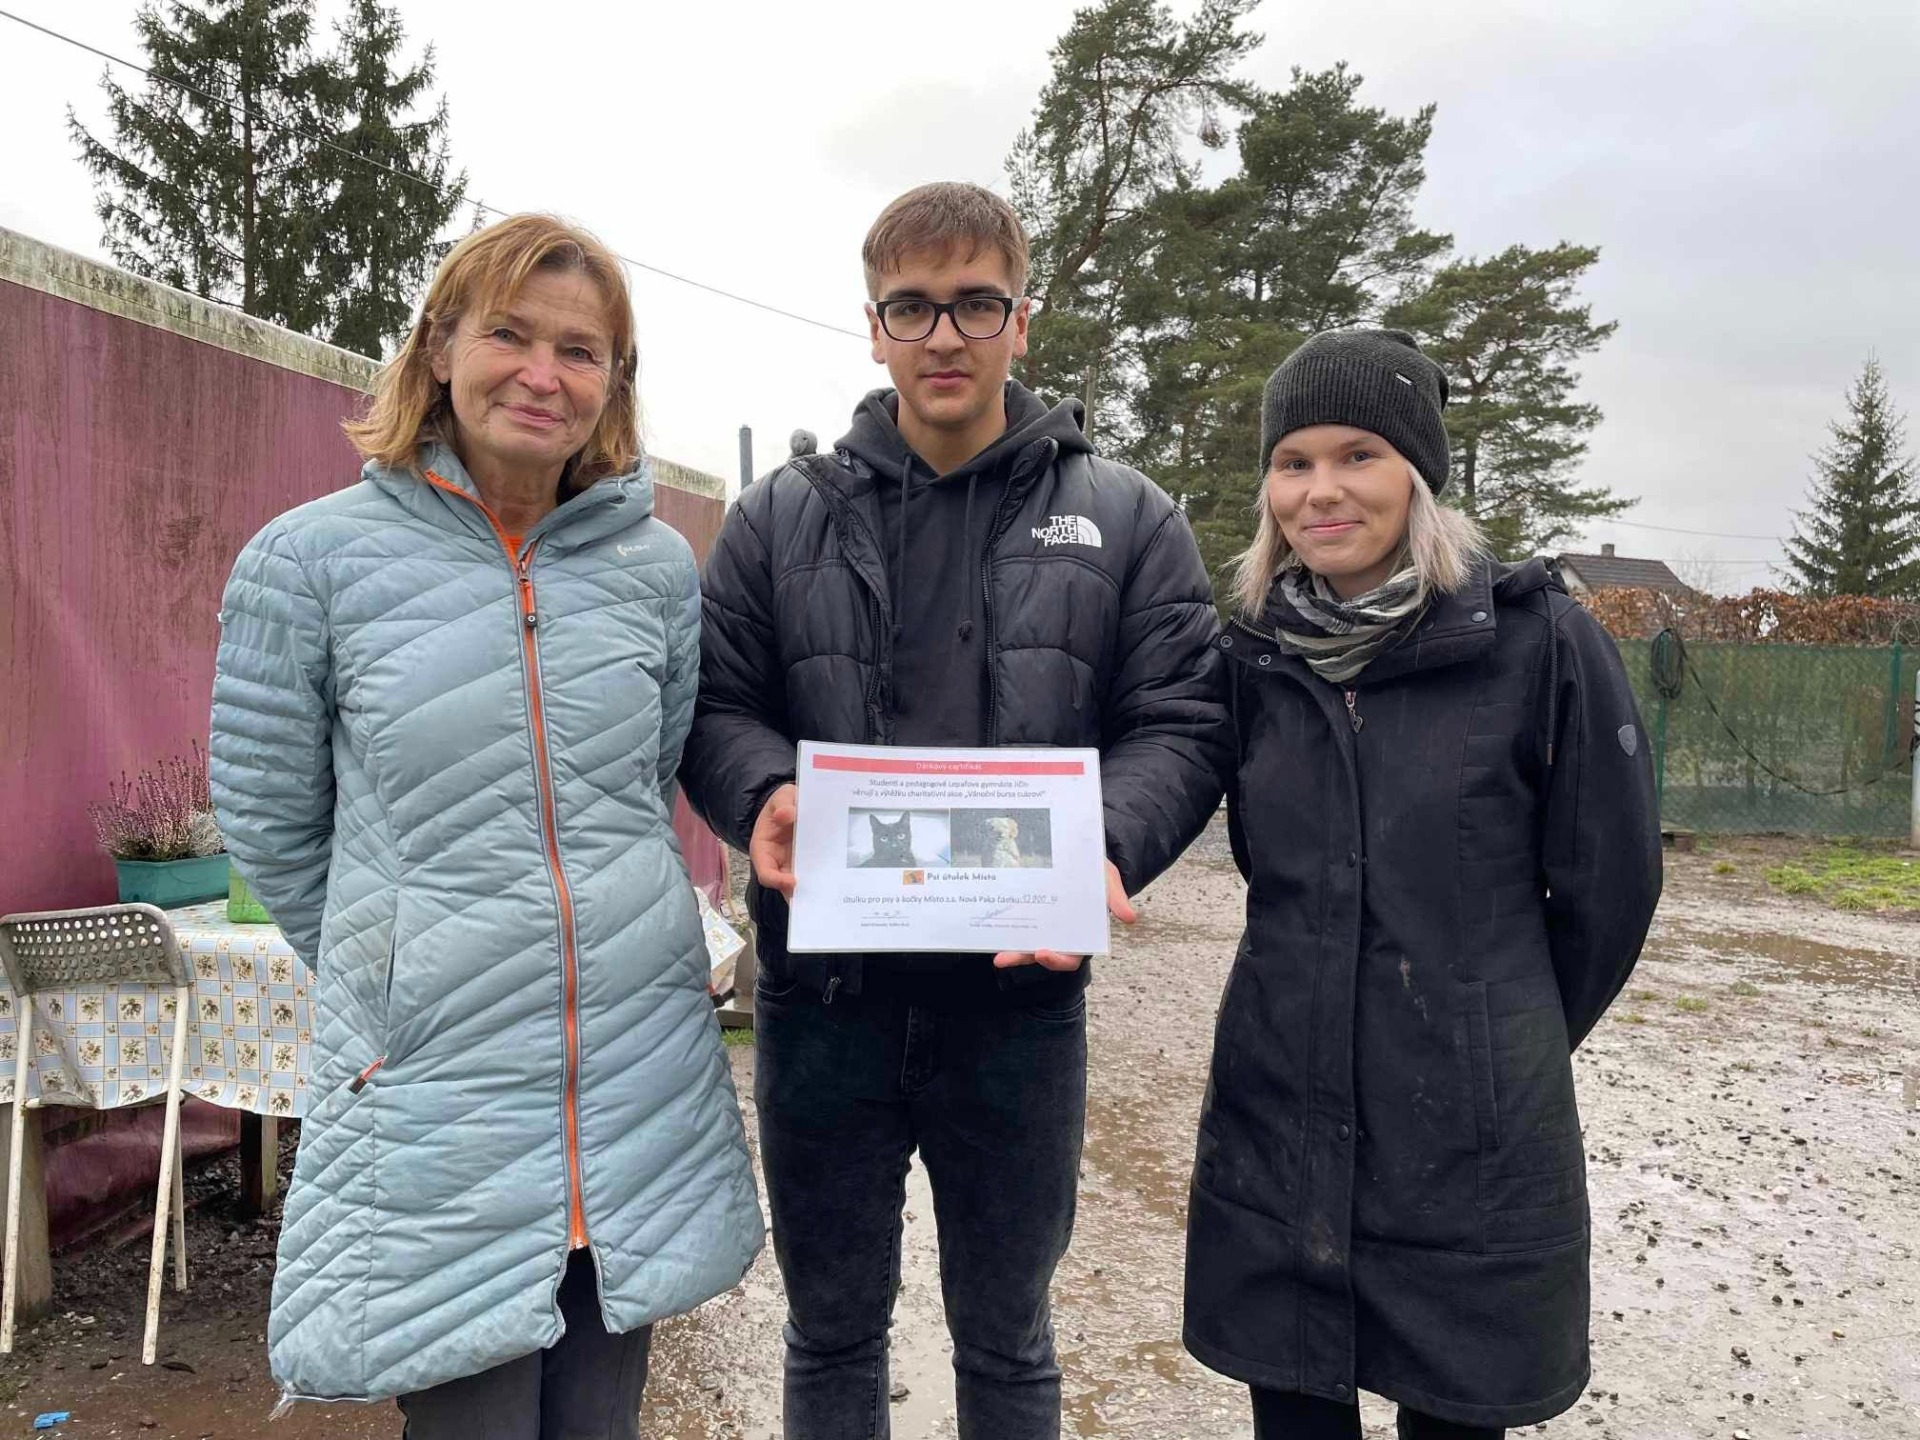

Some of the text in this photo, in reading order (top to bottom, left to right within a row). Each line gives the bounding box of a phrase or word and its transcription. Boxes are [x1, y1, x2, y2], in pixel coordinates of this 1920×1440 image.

[1049, 515, 1077, 526] THE
[1031, 524, 1077, 539] NORTH
[1044, 533, 1078, 547] FACE
[869, 778, 898, 787] Studenti
[905, 779, 946, 788] pedagogové
[901, 895, 922, 904] kočky
